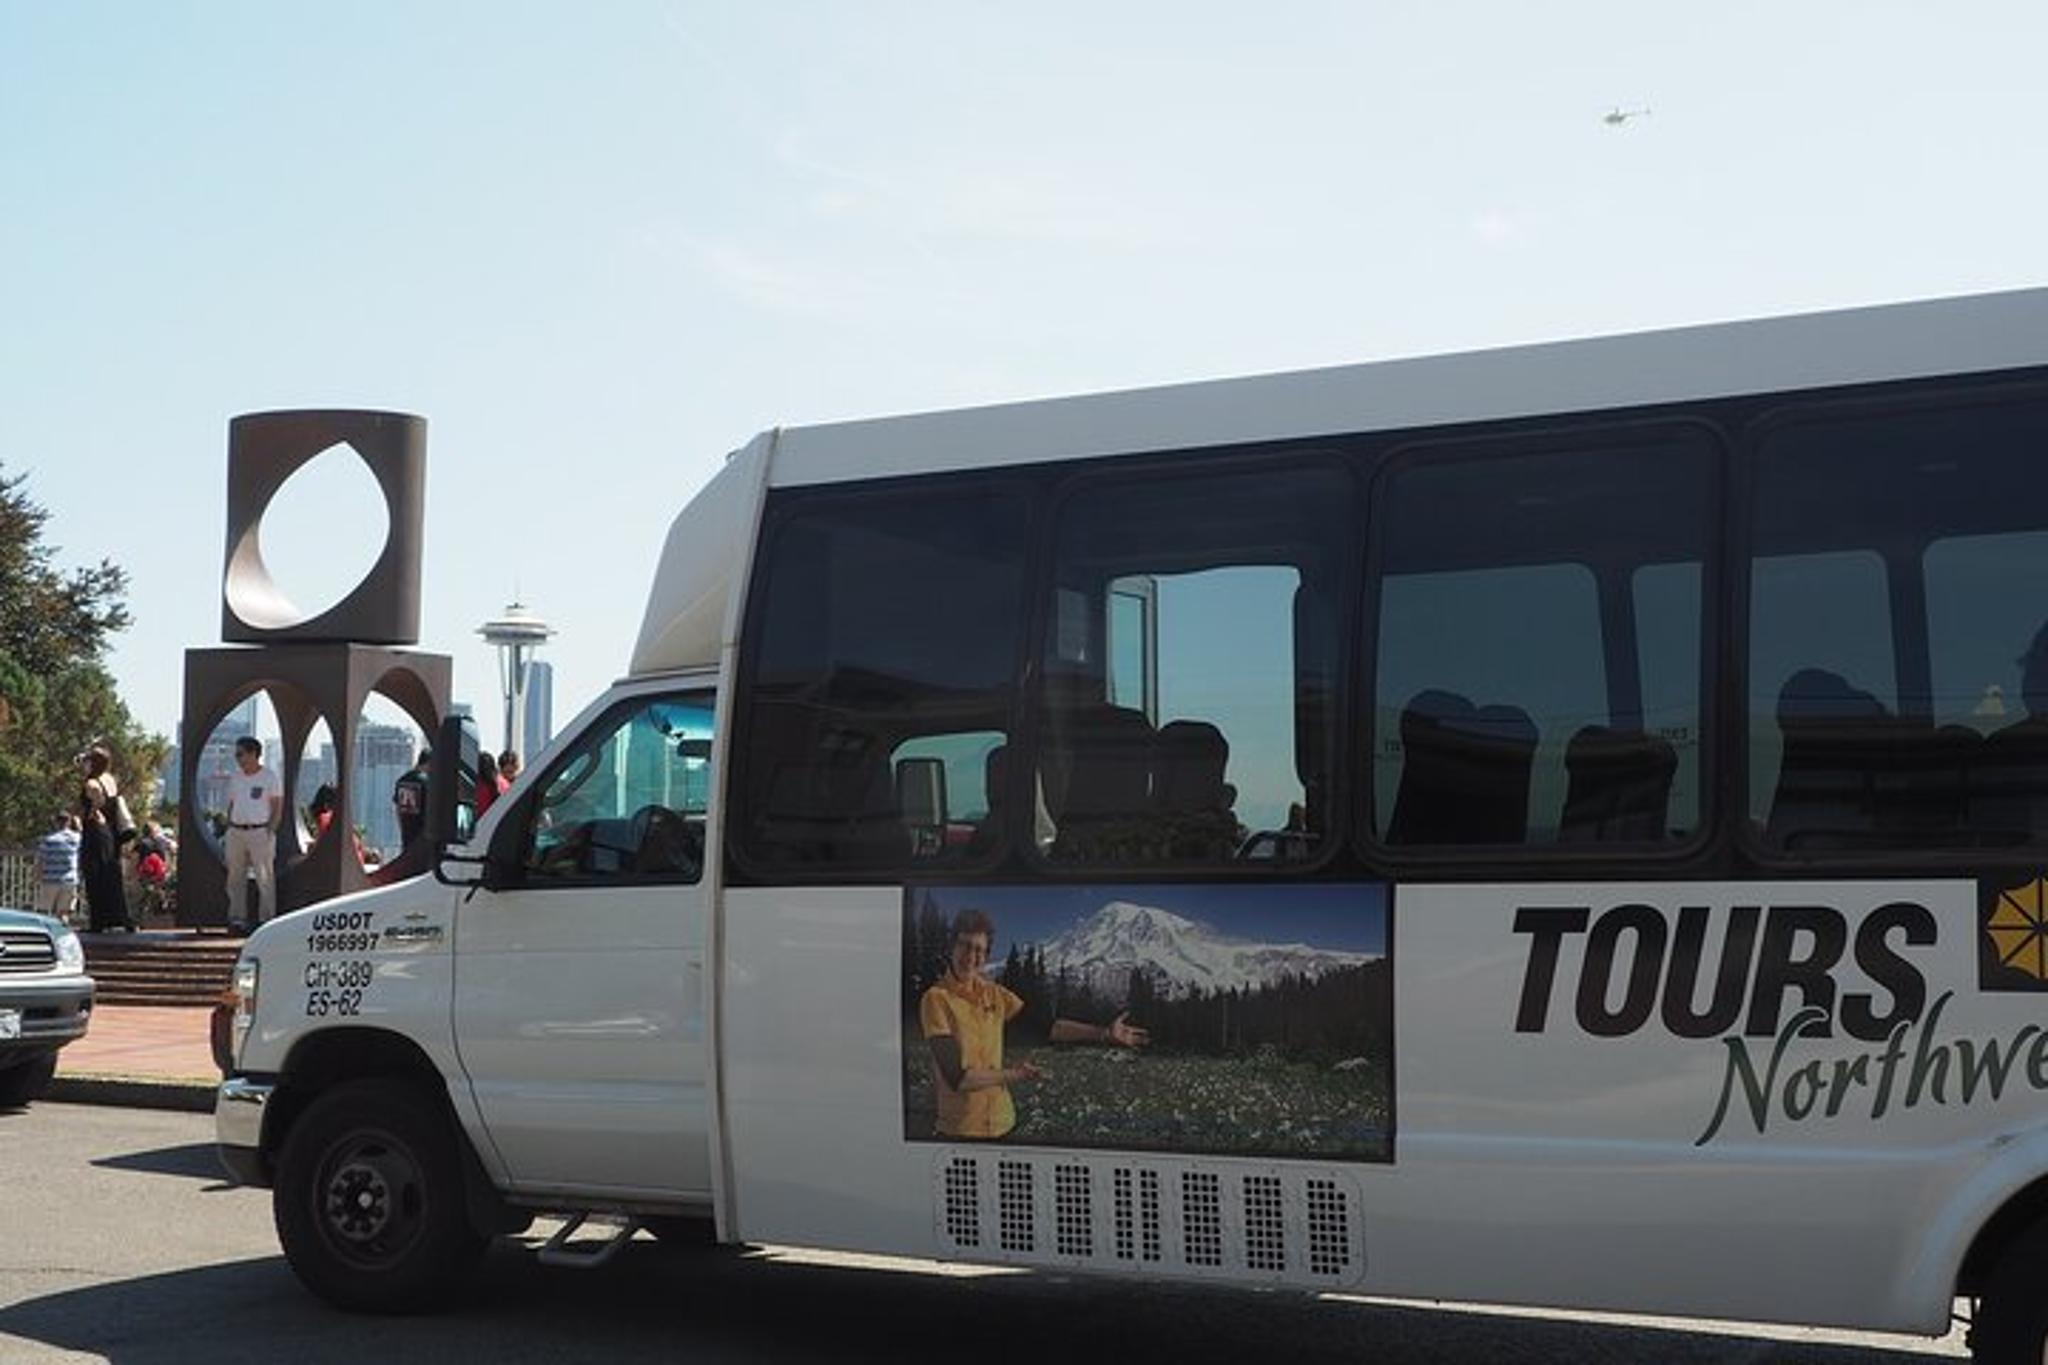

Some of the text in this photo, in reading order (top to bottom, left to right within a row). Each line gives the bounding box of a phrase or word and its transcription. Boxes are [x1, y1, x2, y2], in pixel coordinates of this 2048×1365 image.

[313, 912, 373, 930] USDOT
[305, 961, 373, 987] CH-389
[1513, 902, 1937, 1041] TOURS
[307, 990, 363, 1016] ES-62
